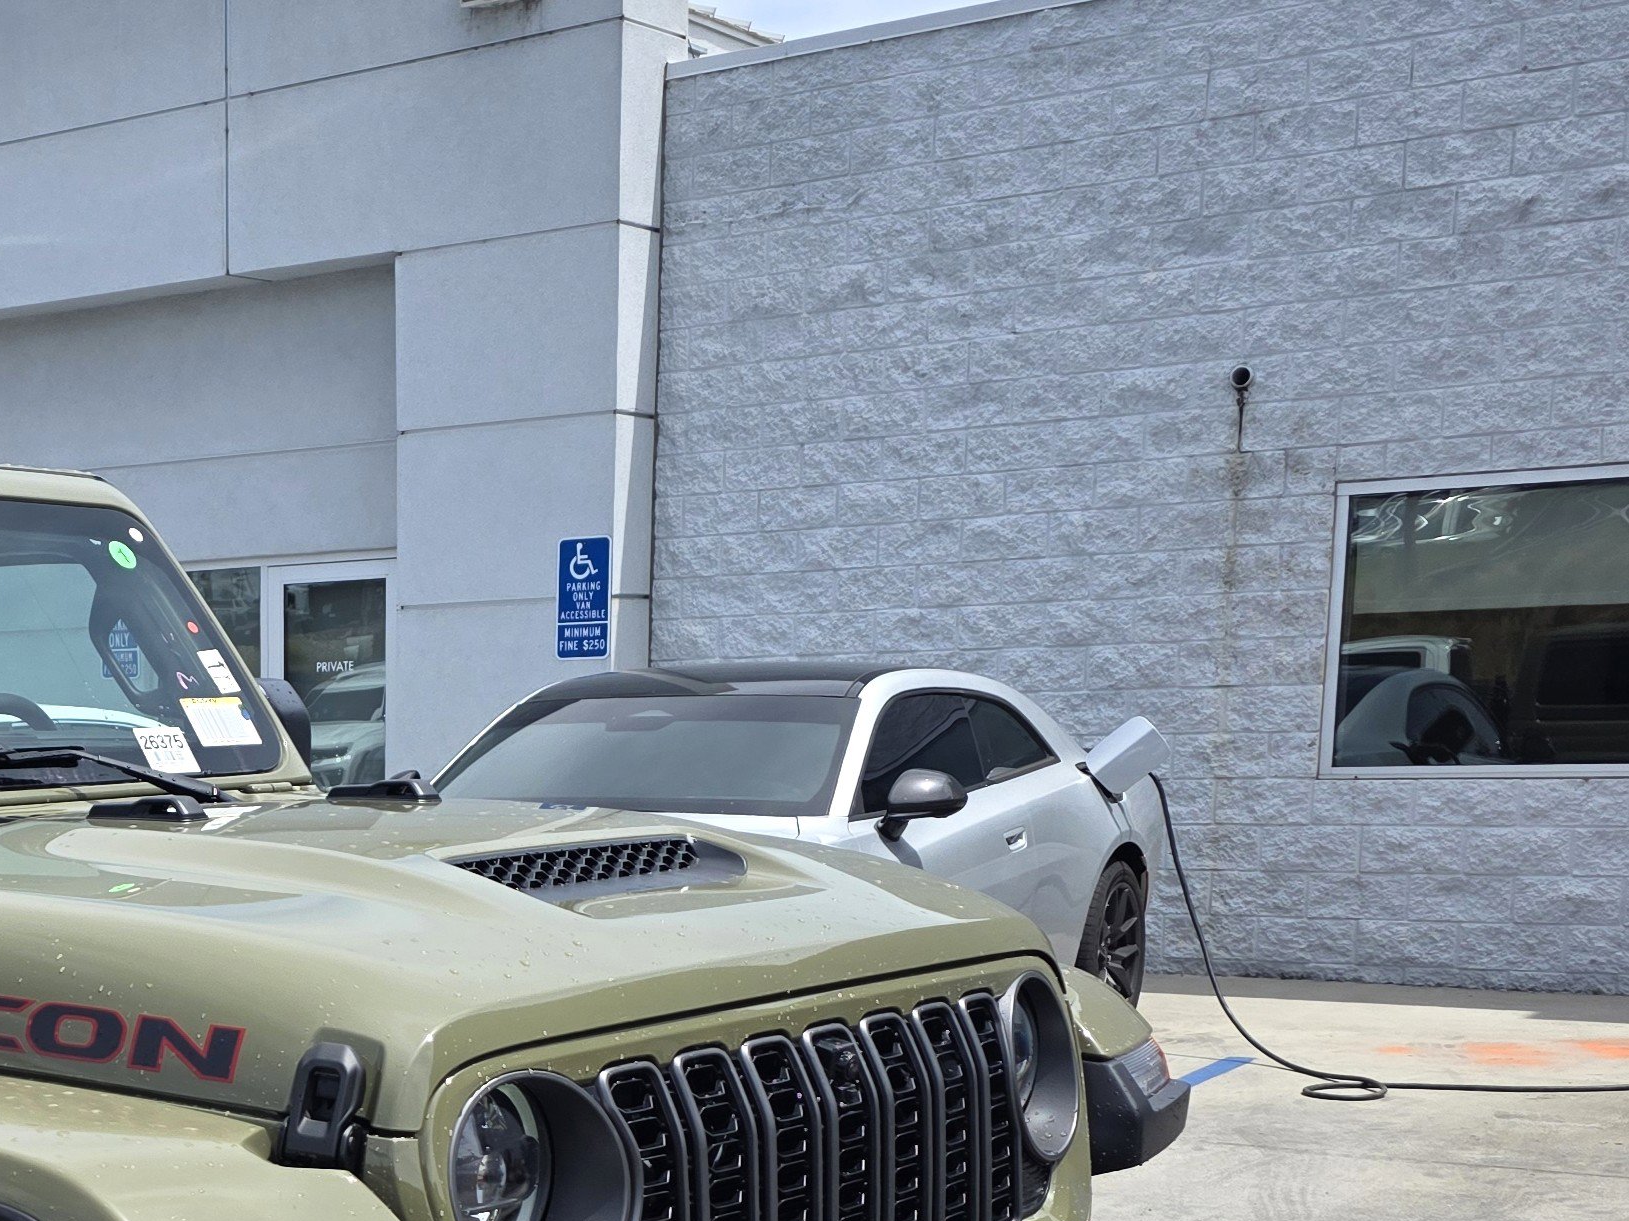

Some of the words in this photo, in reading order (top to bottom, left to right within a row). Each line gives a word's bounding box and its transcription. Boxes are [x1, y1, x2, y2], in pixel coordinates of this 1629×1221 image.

[566, 580, 601, 592] PARKING
[572, 591, 594, 602] ONLY
[575, 601, 591, 610] VAN
[560, 609, 606, 620] ACCESSIBLE
[564, 626, 601, 638] MINIMUM
[108, 631, 130, 648] ONLY
[559, 640, 579, 652] FINE
[582, 639, 605, 651] $250
[316, 660, 354, 673] PRIVATE
[139, 734, 184, 750] 26375
